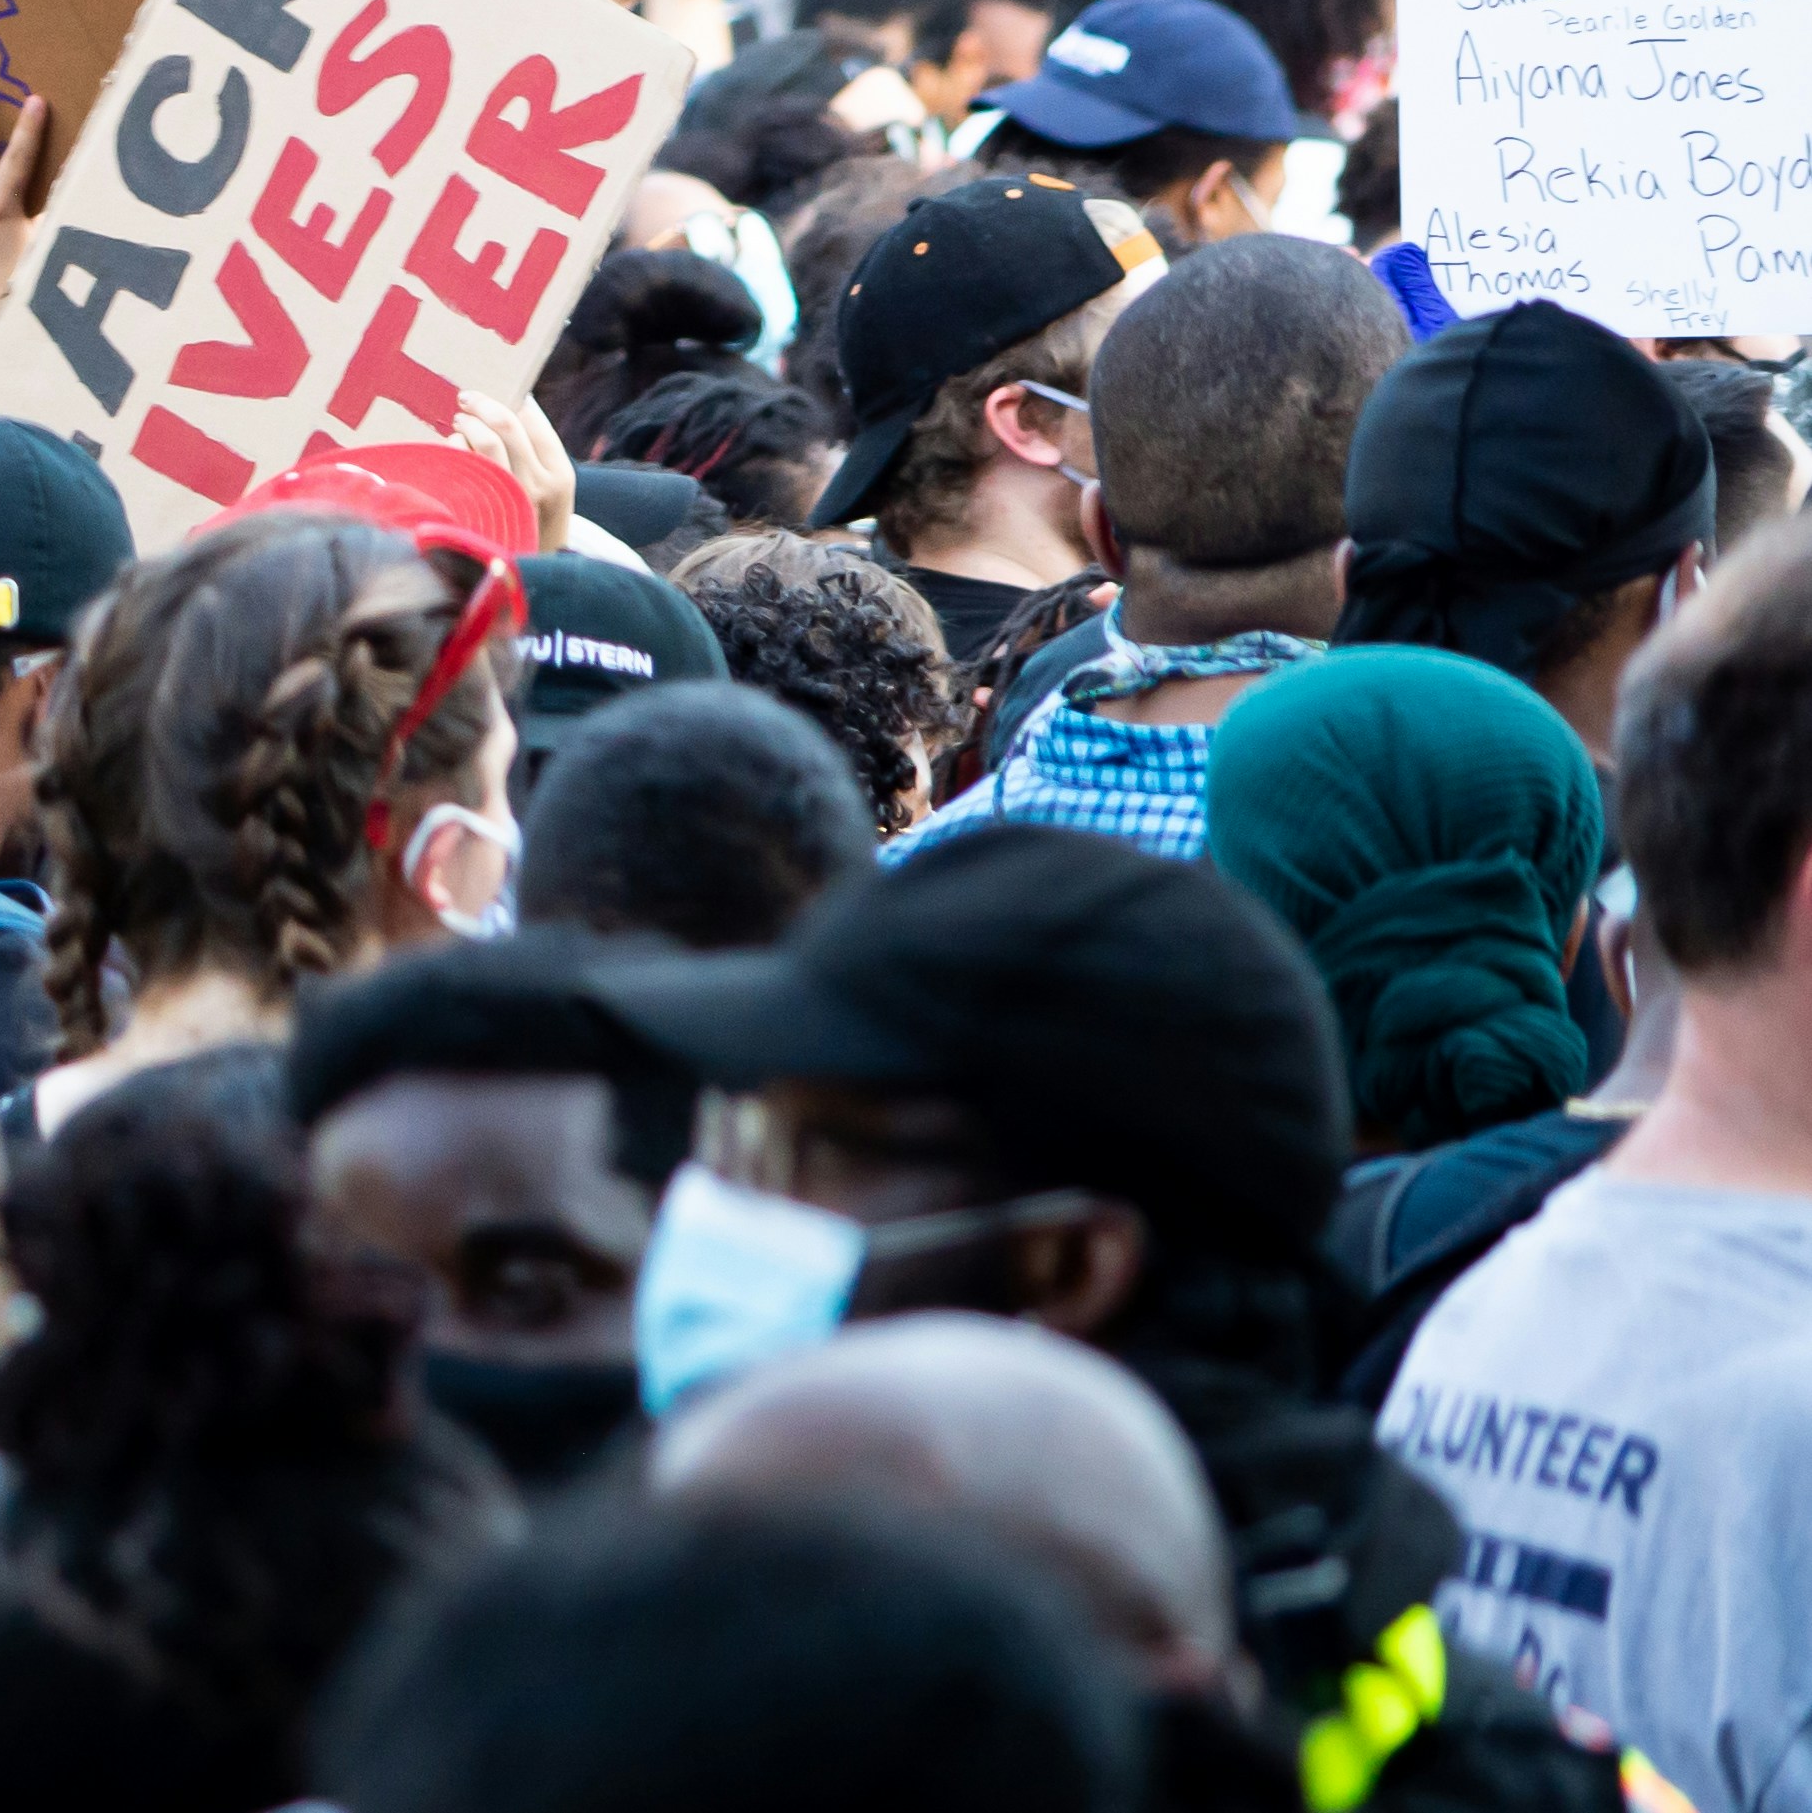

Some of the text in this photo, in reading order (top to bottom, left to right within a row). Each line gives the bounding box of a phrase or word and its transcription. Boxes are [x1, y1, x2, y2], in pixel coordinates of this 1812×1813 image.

[1661, 3, 1757, 32] Golden
[1455, 30, 1766, 129] Aiyana Jones
[1493, 135, 1668, 205] Rekia
[302, 52, 645, 461] TER
[1426, 207, 1812, 283] Alesia Pam
[1428, 259, 1592, 296] Thomas
[1626, 277, 1718, 309] Shelly
